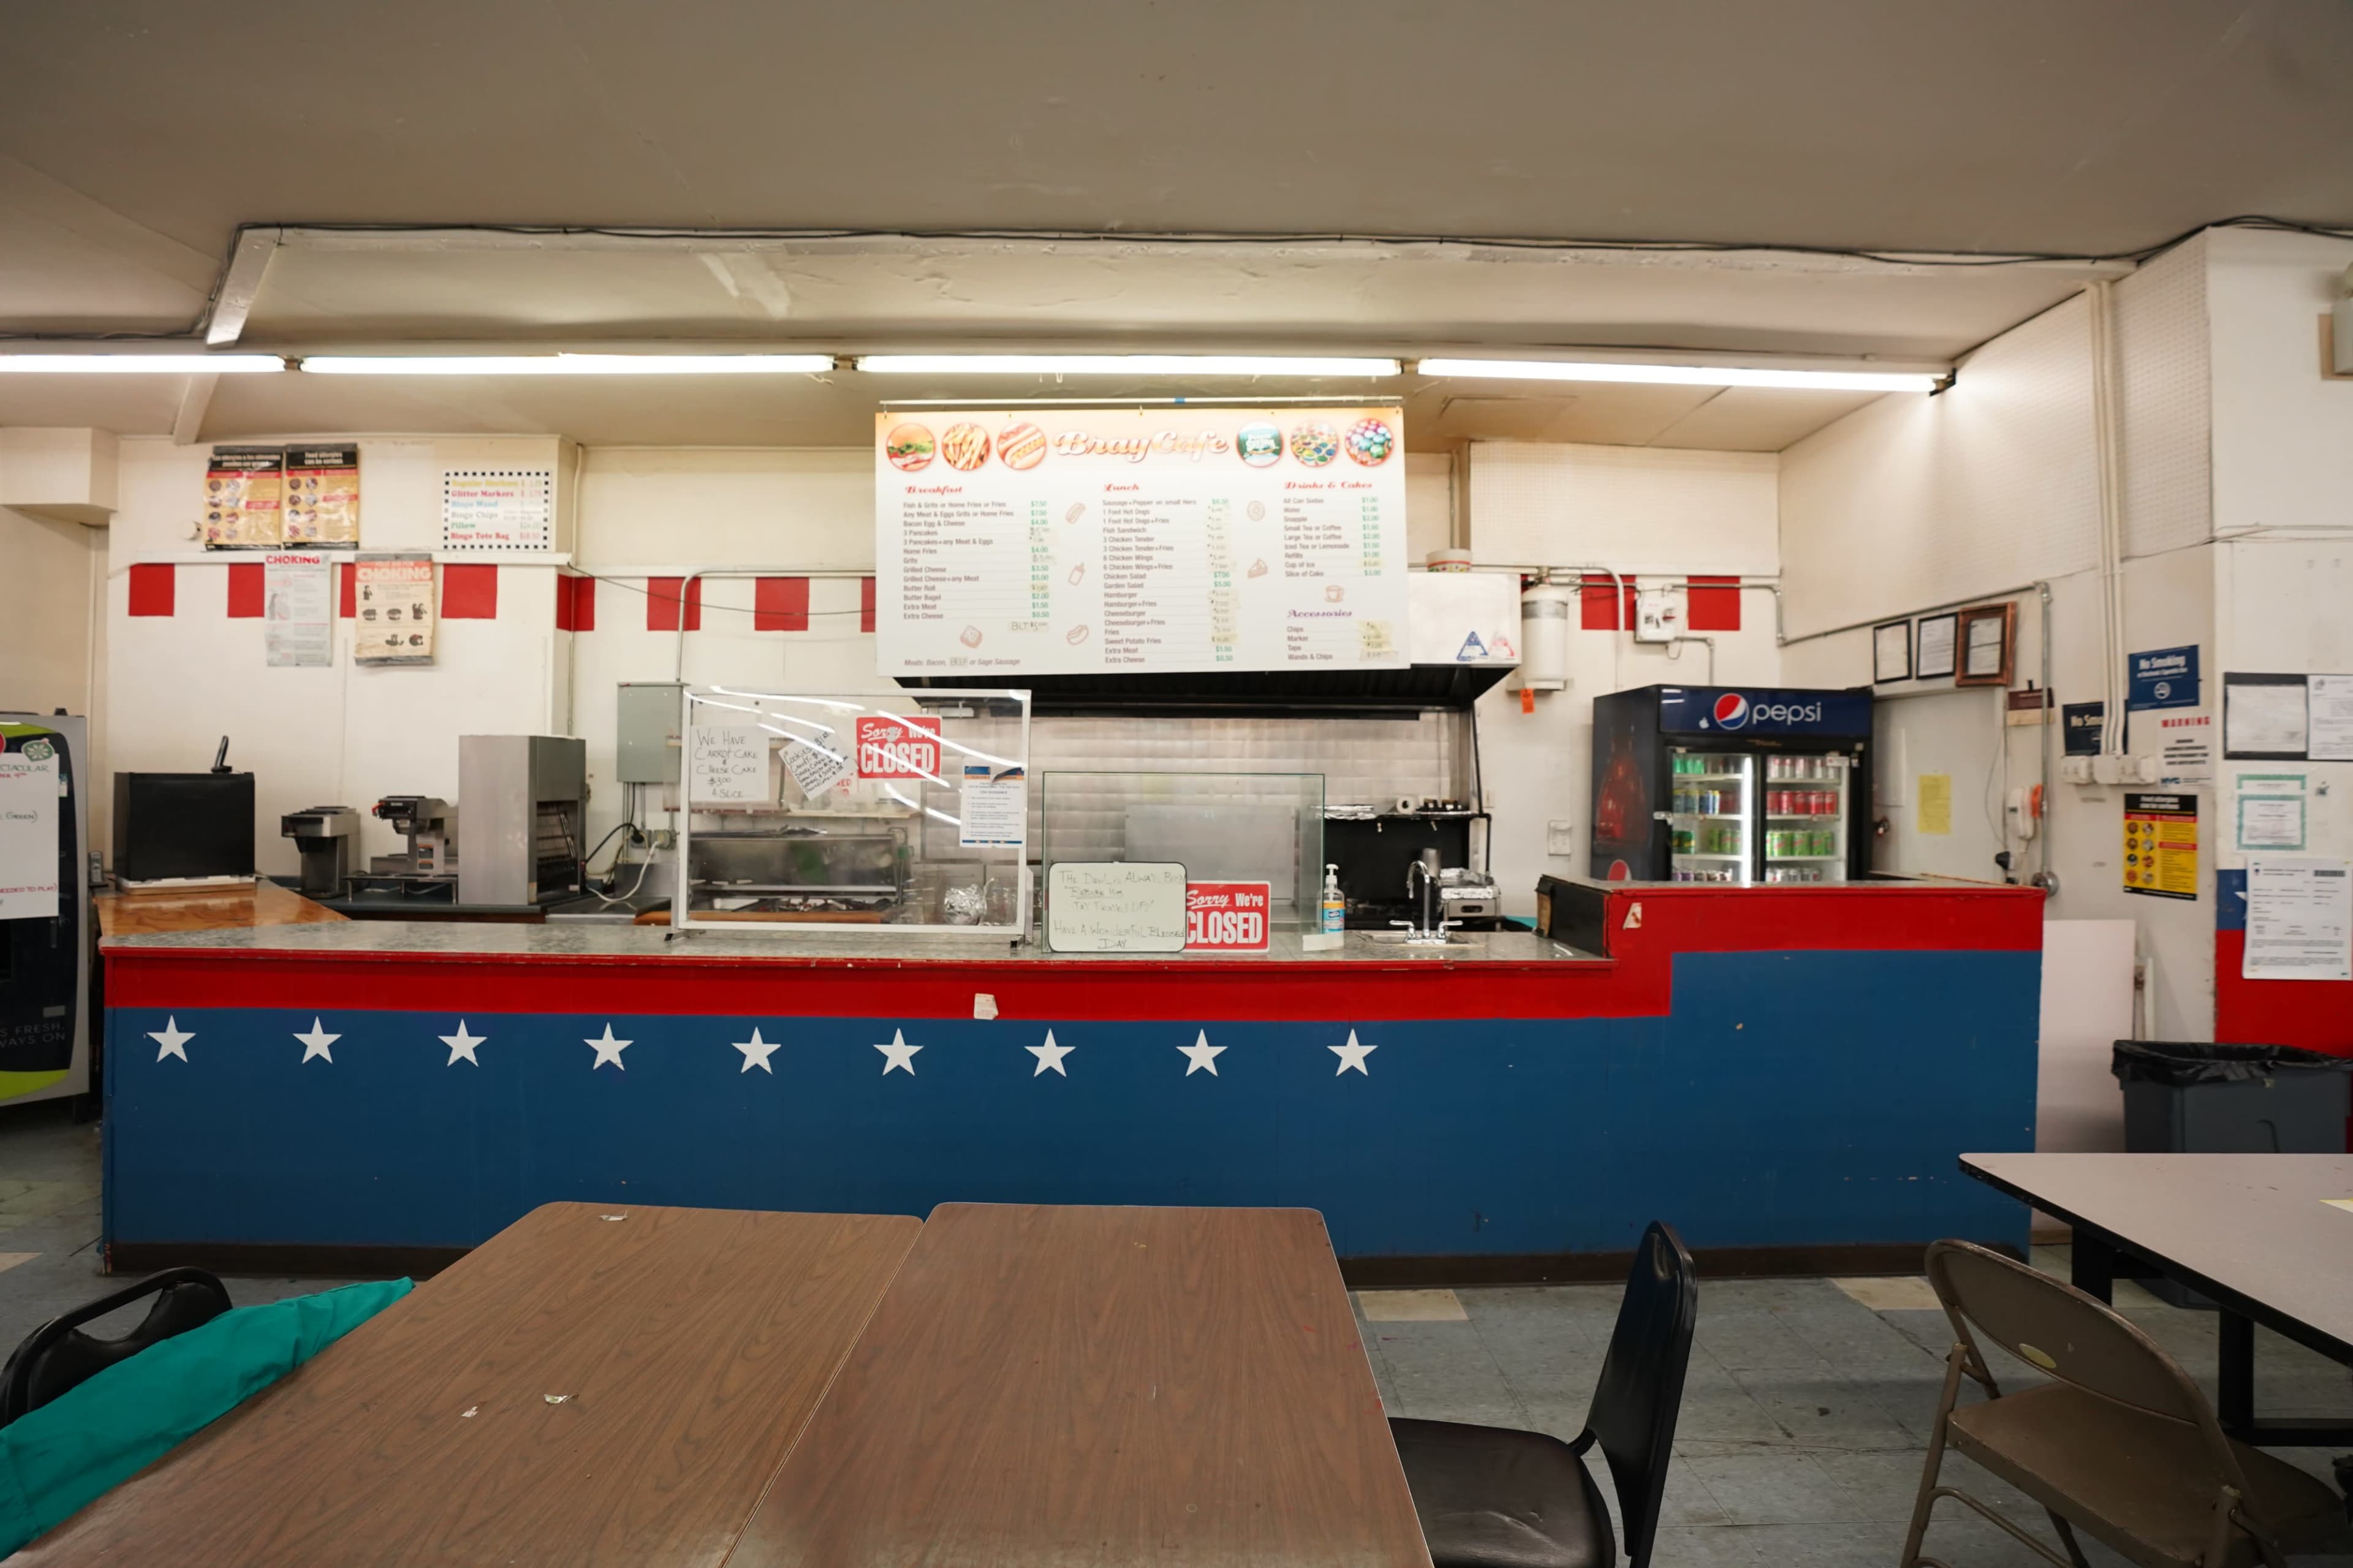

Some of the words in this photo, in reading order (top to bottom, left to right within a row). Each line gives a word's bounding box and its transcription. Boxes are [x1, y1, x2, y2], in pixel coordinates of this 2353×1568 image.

[1053, 430, 1150, 463] Bray
[1151, 430, 1229, 461] Cafe
[905, 486, 963, 495] Breakfast
[266, 555, 320, 564] CHOKING
[357, 567, 431, 581] CHOKING
[1287, 608, 1352, 618] Accessories
[2139, 659, 2151, 670] No
[2150, 655, 2186, 668] Smoking
[1752, 702, 1821, 725] pepsi
[2161, 716, 2210, 728] WARNING
[722, 730, 746, 745] HAVE
[861, 722, 904, 742] Sorry
[907, 727, 937, 740] We're
[734, 749, 760, 759] CAKE
[860, 742, 935, 774] CLOSED
[696, 763, 729, 775] CHEESE
[731, 763, 757, 775] CAKE
[711, 787, 718, 798] A
[719, 788, 745, 798] SLICE
[6, 809, 38, 824] GREEN)
[1059, 870, 1078, 884] THE
[1187, 890, 1230, 908] Sorry
[1235, 893, 1264, 907] We're
[1080, 923, 1088, 935] A
[1186, 911, 1263, 944] CLOSED
[1097, 937, 1128, 949] DAY
[42, 1032, 65, 1043] ON
